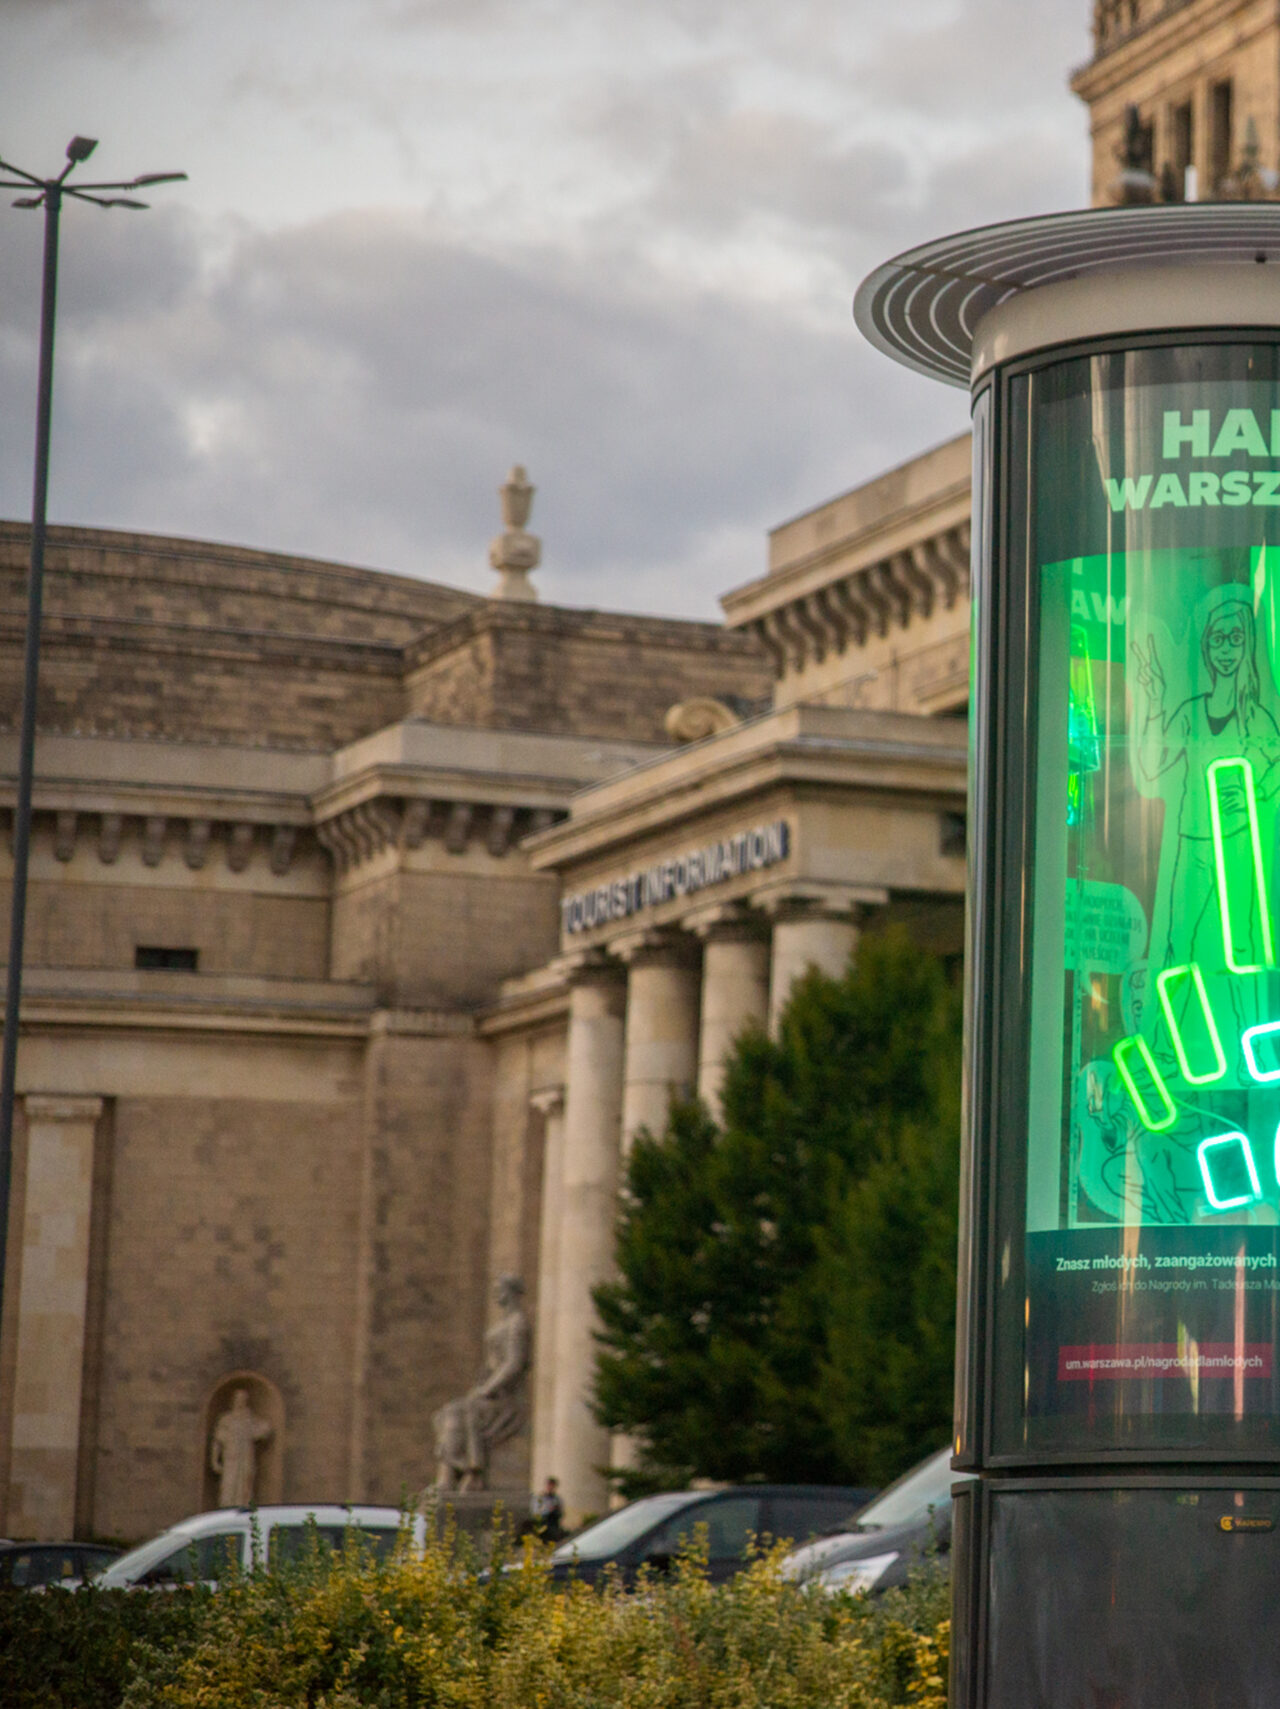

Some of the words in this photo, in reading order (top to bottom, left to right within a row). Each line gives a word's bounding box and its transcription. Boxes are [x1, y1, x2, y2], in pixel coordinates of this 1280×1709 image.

[643, 820, 789, 907] INFORMATION
[1056, 1257, 1091, 1272] Znasz
[1092, 1254, 1152, 1271] młodych,
[1154, 1252, 1277, 1271] zaangażowanych
[1135, 1280, 1147, 1291] do
[1149, 1279, 1192, 1293] Nagrody
